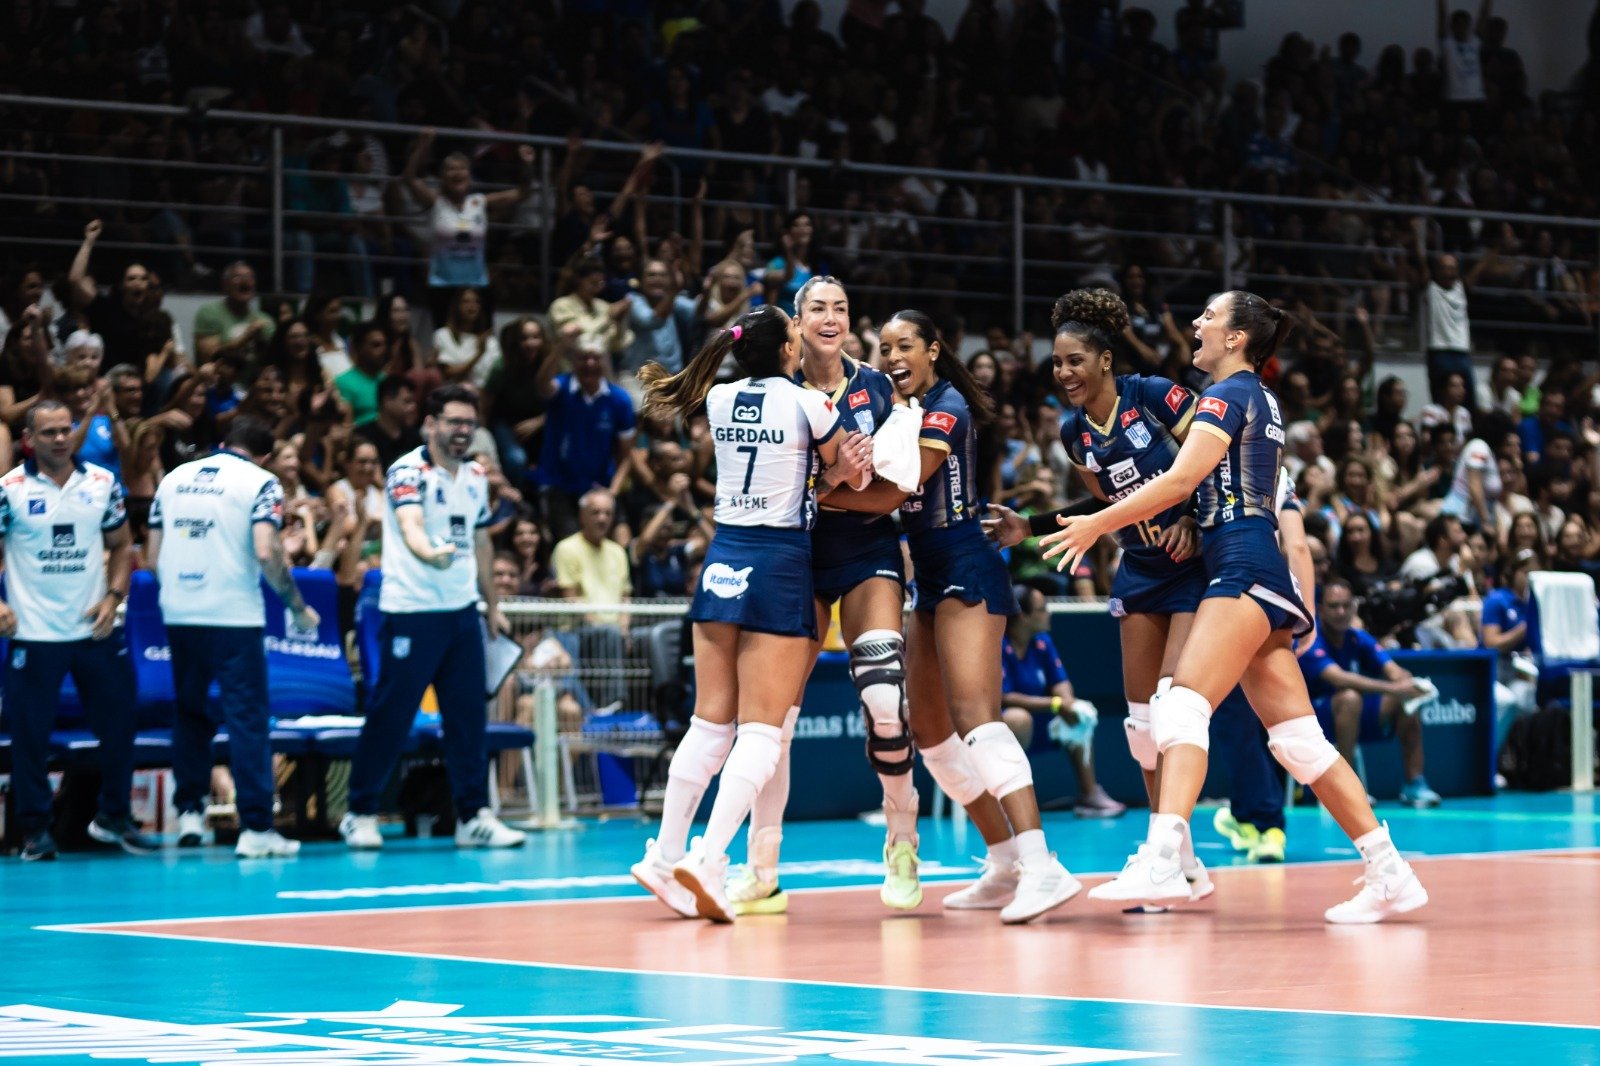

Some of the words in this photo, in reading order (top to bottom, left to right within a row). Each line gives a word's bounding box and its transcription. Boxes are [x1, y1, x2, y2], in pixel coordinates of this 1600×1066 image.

[715, 428, 785, 444] GERDAU
[736, 446, 758, 495] 7
[947, 454, 964, 511] ESTRELA
[710, 573, 742, 586] itambé
[1421, 697, 1476, 724] clube
[796, 715, 843, 738] nas
